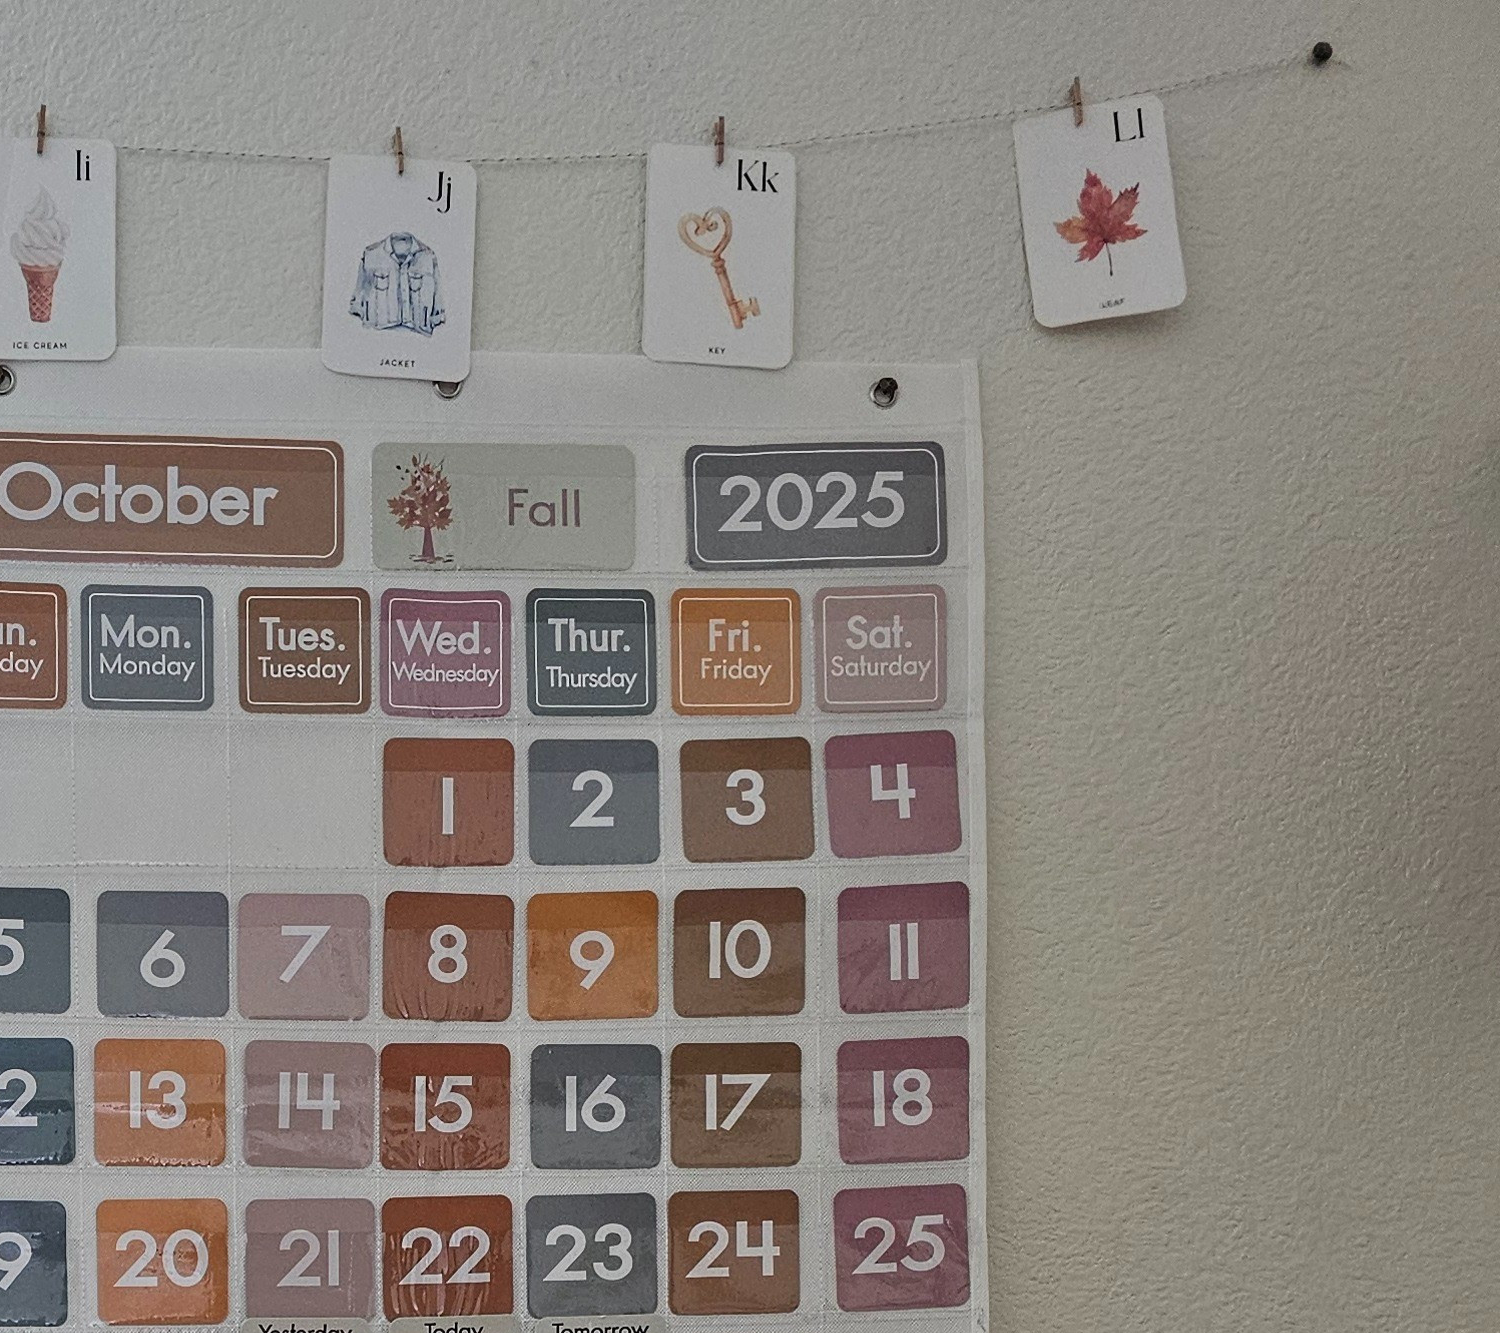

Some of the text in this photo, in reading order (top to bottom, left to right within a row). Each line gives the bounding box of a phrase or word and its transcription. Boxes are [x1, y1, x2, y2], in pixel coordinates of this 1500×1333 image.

[1113, 108, 1145, 142] Ll
[75, 150, 91, 181] Ii
[427, 171, 452, 214] Jj
[737, 159, 779, 193] Kk
[12, 341, 68, 350] ICE CREAM
[379, 358, 415, 368] JACKET
[708, 346, 726, 355] KEY
[507, 488, 581, 528] Fall
[718, 470, 906, 533] 2025
[100, 613, 192, 649] Mon.
[258, 617, 346, 652] Tues.
[396, 619, 491, 656] Wed.
[548, 617, 631, 653] Thur.
[708, 619, 761, 653] Fri.
[845, 614, 912, 650] Sat.
[99, 653, 196, 683] Monday
[257, 657, 351, 685] Tuesday
[392, 663, 499, 688] Wednesday
[545, 665, 638, 695] Thursday
[701, 658, 773, 686] Friday
[830, 655, 932, 682] Saturday
[441, 777, 455, 836] 1
[569, 770, 615, 828] 2
[724, 768, 767, 827] 3
[870, 763, 917, 820] 4
[140, 930, 186, 988] 6
[279, 925, 331, 983] 7
[427, 924, 469, 984] 8
[569, 930, 615, 991] 9
[707, 919, 772, 980] 10
[888, 922, 920, 982] 11
[128, 1070, 187, 1129] 13
[278, 1071, 341, 1131] 14
[414, 1075, 474, 1133] 15
[564, 1074, 627, 1133] 16
[705, 1073, 772, 1132] 17
[872, 1068, 933, 1128] 18
[113, 1229, 209, 1288] 20
[276, 1229, 340, 1287] 21
[399, 1226, 491, 1285] 22
[542, 1223, 634, 1282] 23
[685, 1219, 781, 1279] 24
[851, 1214, 946, 1276] 25
